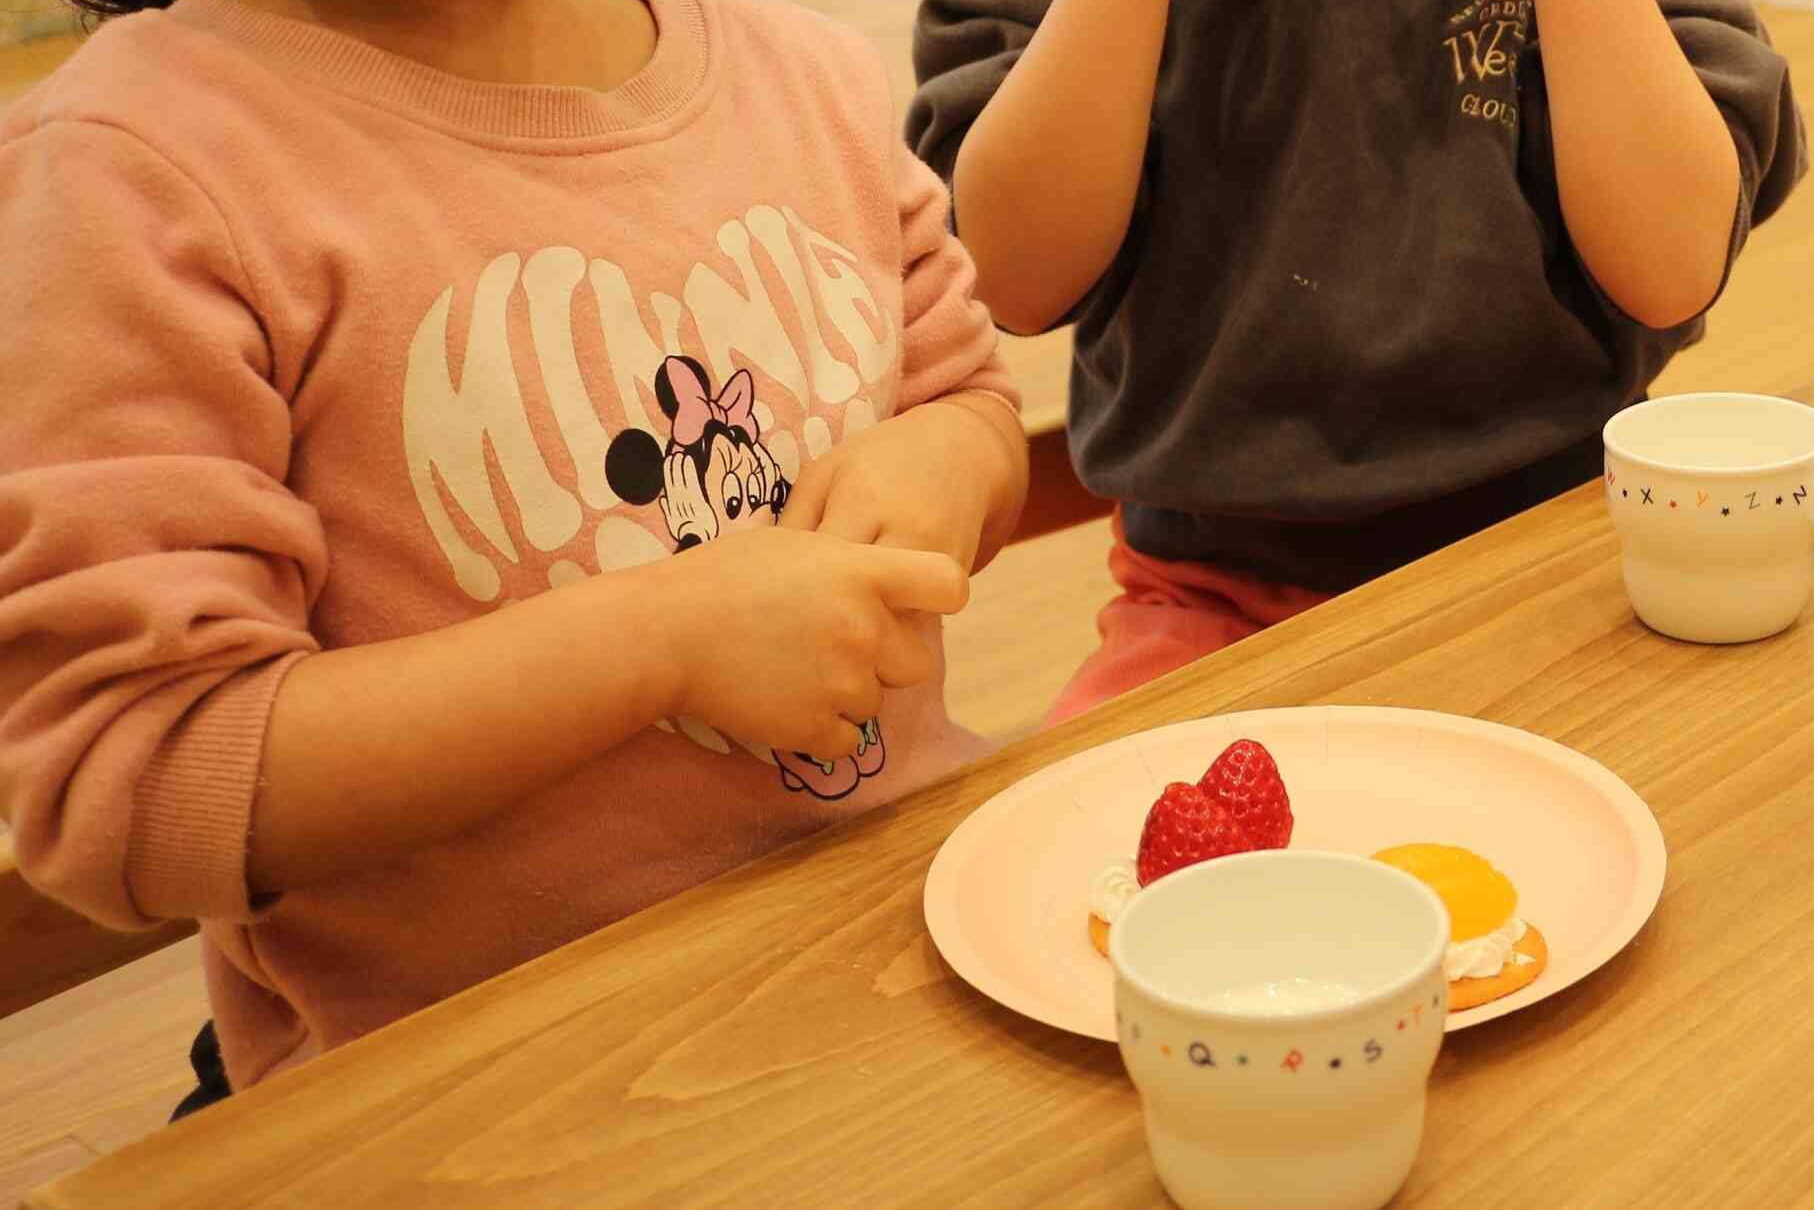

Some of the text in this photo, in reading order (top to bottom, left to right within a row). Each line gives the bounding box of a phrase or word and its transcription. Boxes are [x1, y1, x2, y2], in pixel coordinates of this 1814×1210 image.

[402, 204, 896, 602] MINNIE
[1640, 487, 1654, 504] X
[1744, 491, 1761, 509] Z
[1187, 1040, 1217, 1067] Q
